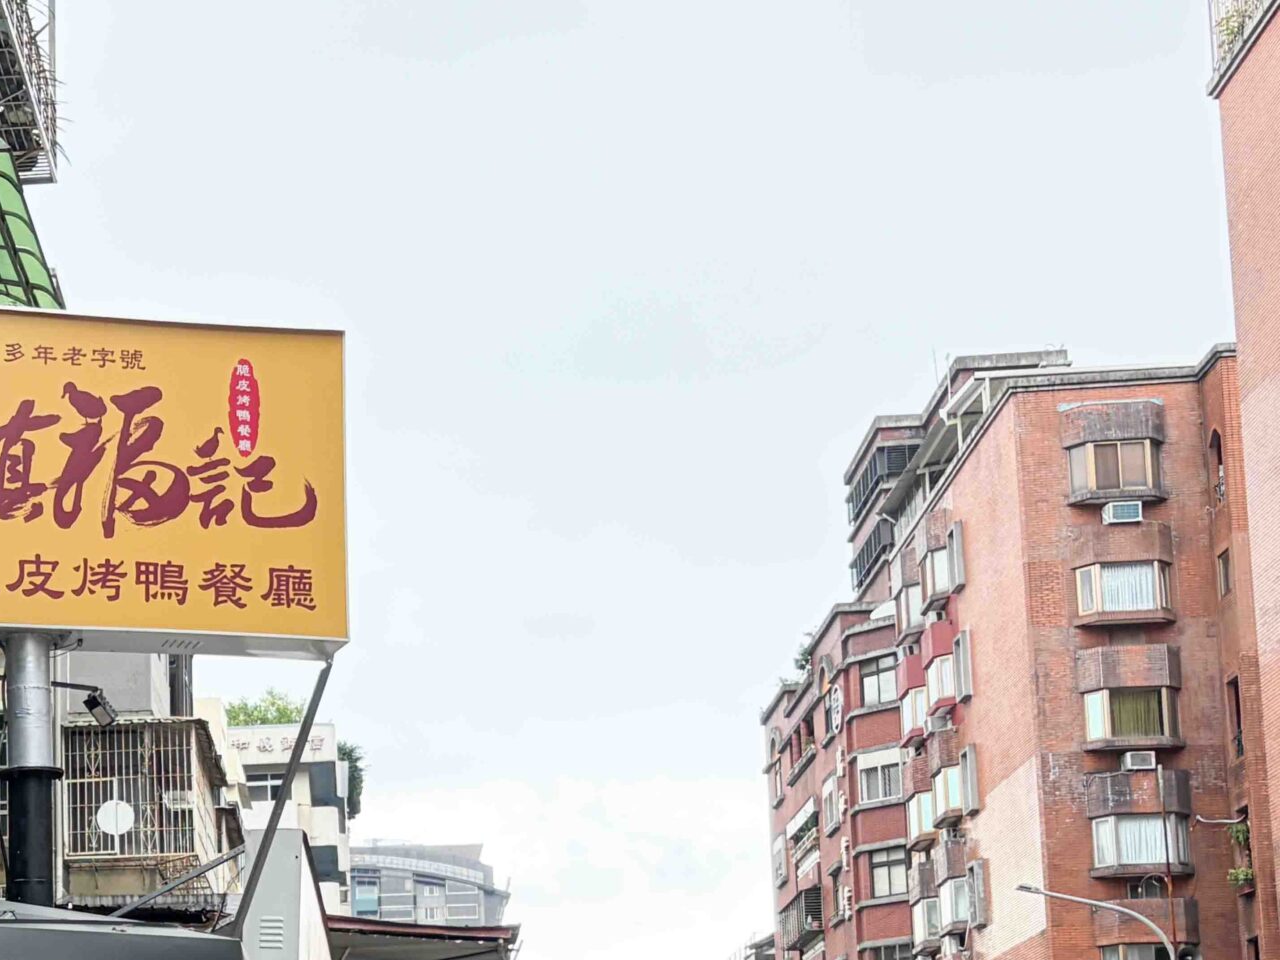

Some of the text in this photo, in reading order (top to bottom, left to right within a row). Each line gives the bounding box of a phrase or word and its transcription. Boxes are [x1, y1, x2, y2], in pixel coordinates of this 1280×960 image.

[235, 364, 252, 452] 脆皮烤鴨餐廳
